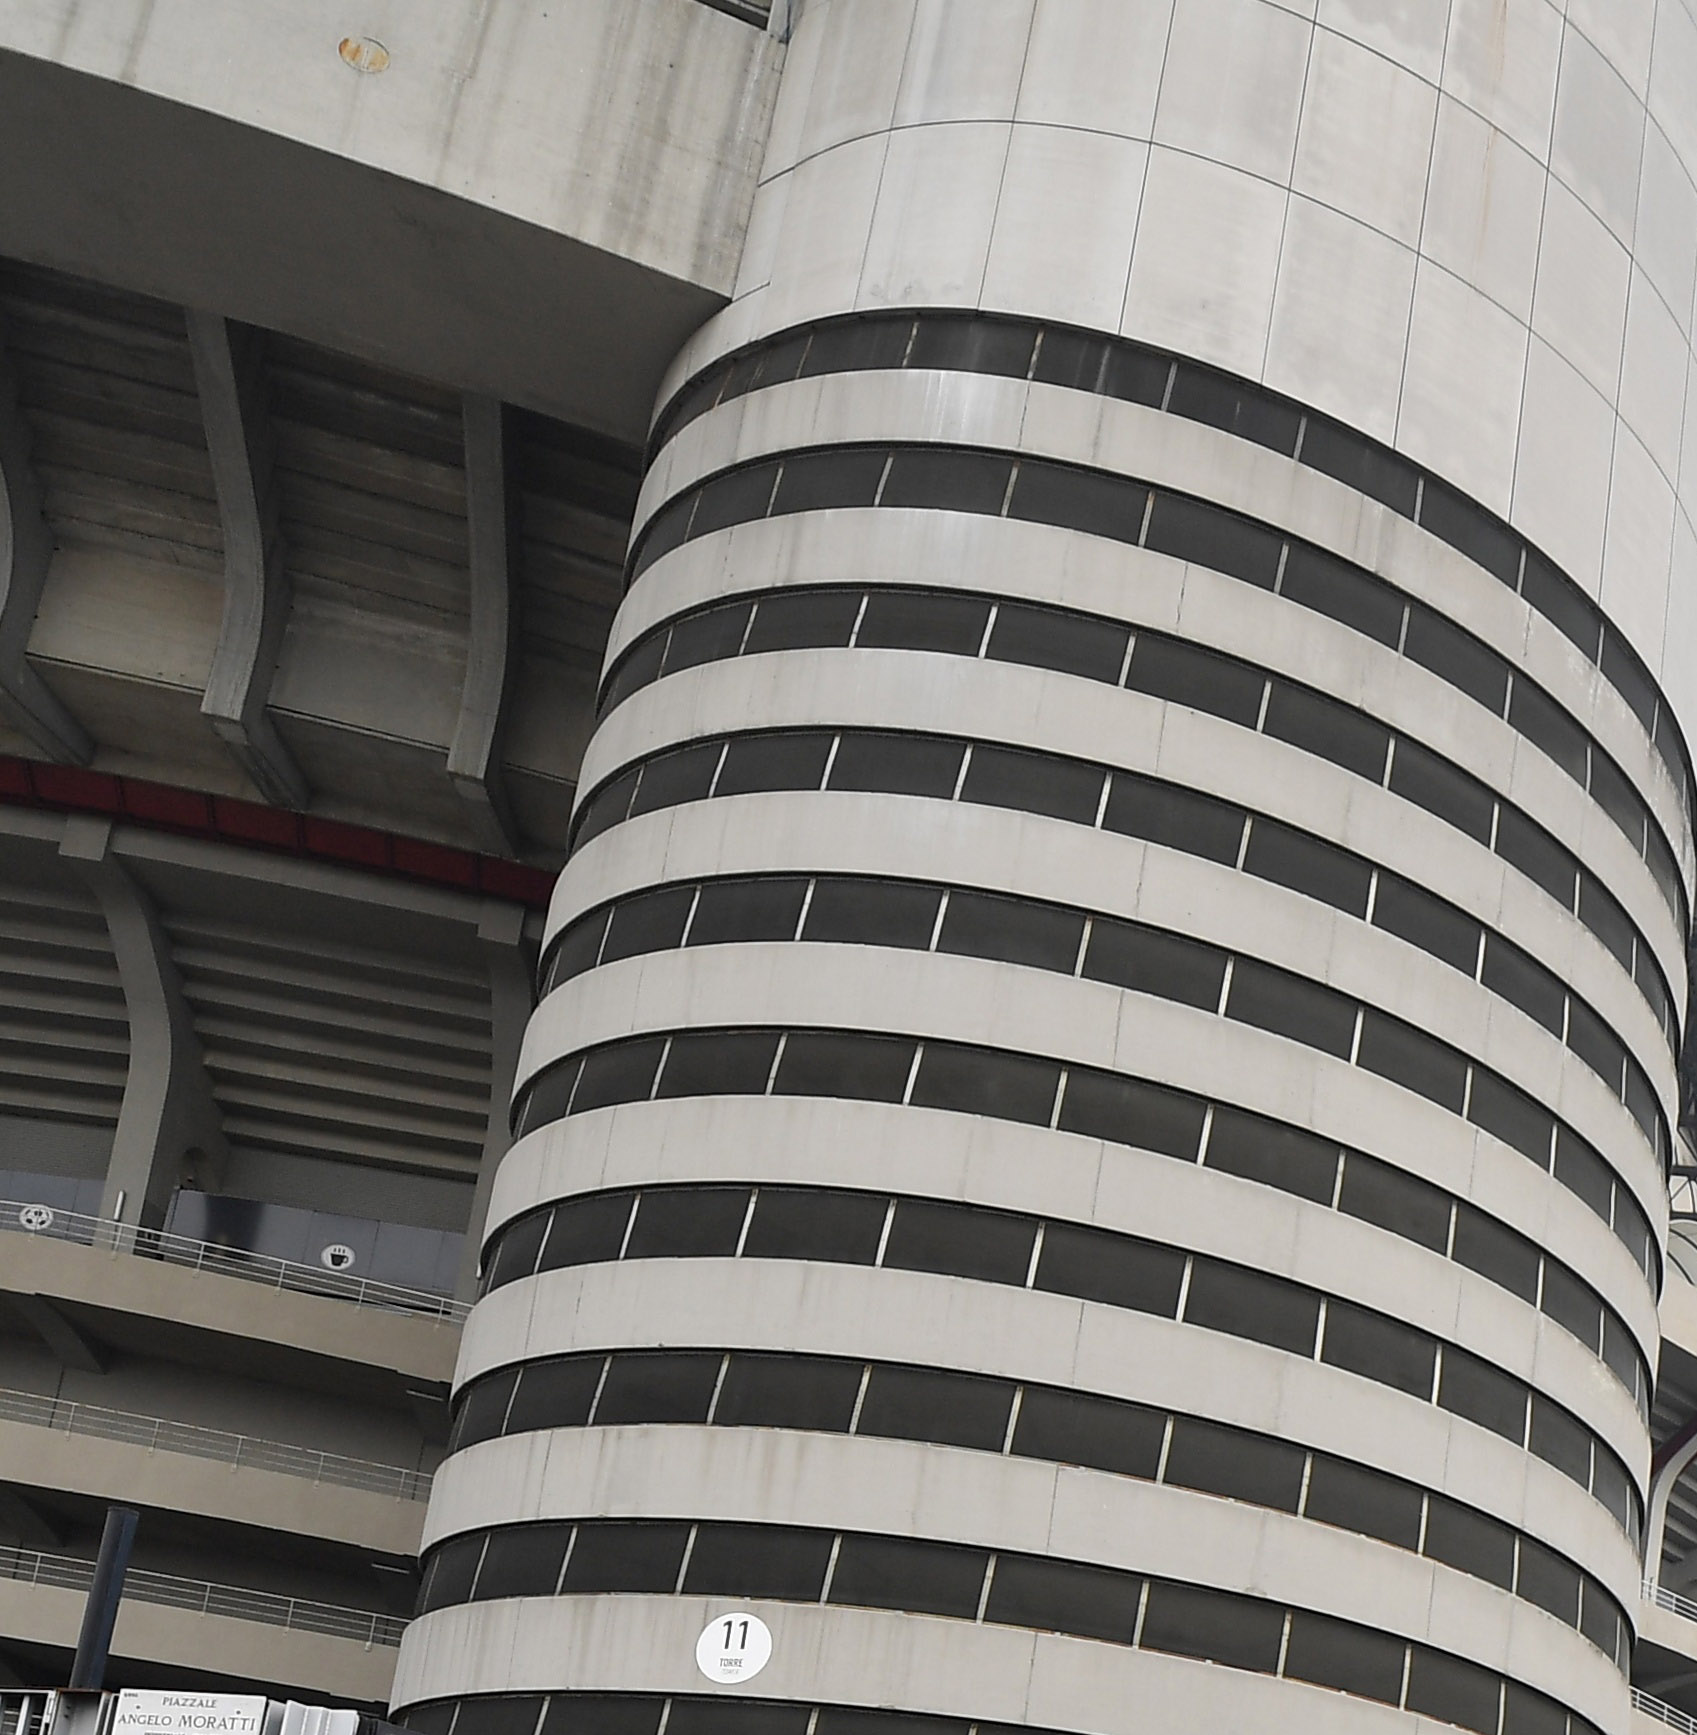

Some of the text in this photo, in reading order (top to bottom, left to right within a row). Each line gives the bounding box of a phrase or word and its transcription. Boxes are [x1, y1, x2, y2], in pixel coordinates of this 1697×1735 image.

[722, 1620, 749, 1650] 11
[719, 1658, 744, 1668] TORRE
[162, 1696, 218, 1709] PIAZZALE
[118, 1713, 256, 1731] ANGELO MORATTI
